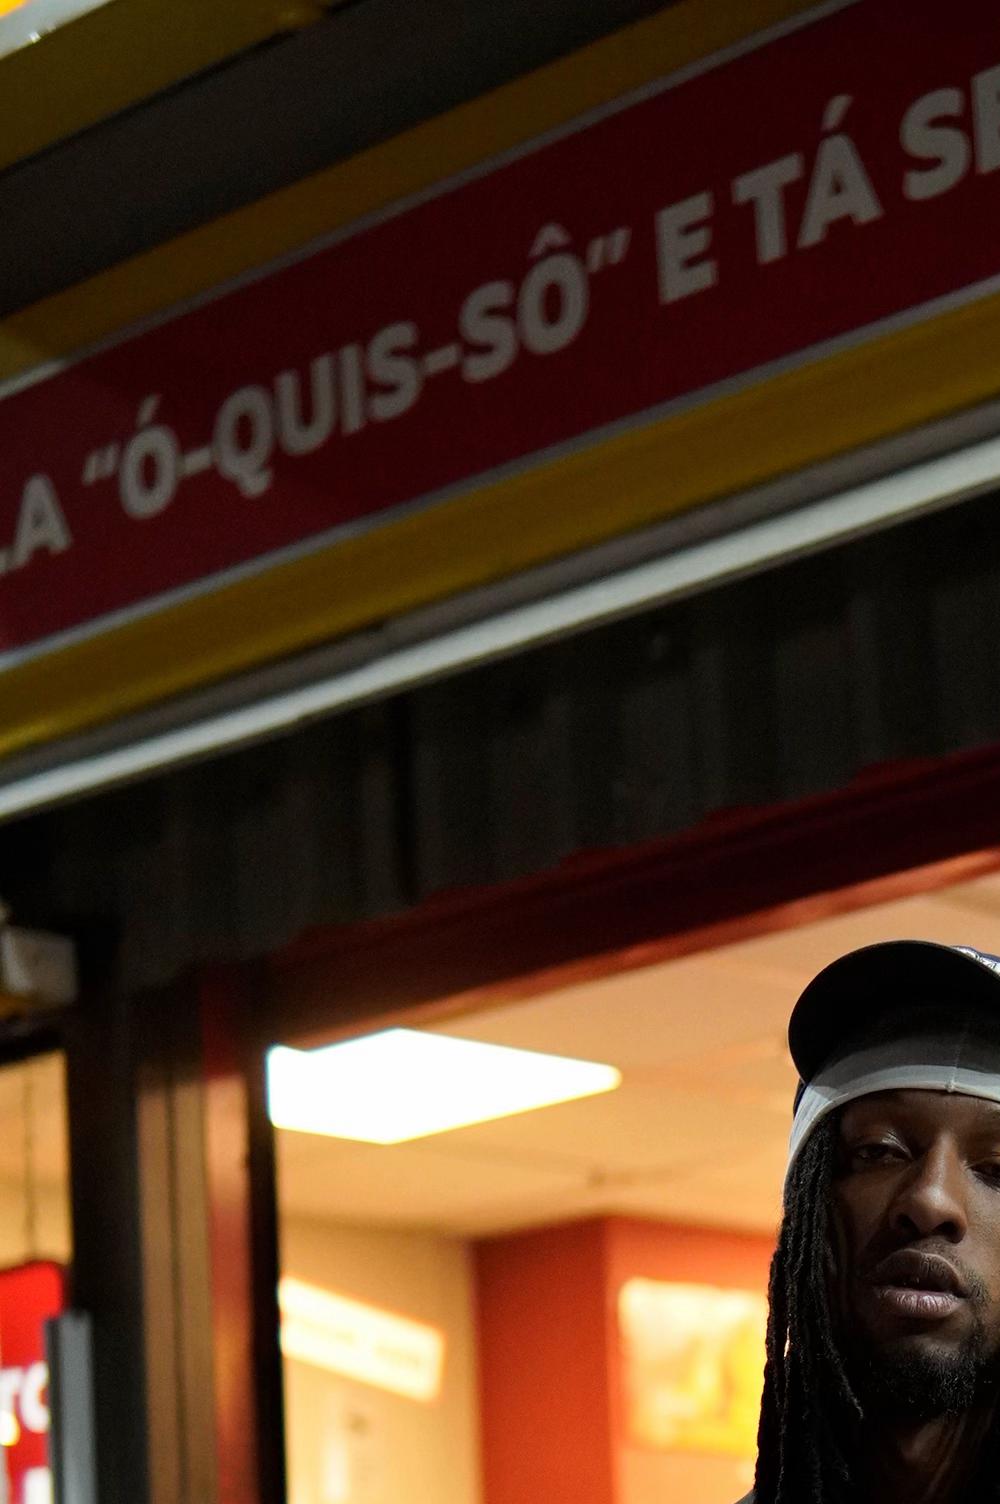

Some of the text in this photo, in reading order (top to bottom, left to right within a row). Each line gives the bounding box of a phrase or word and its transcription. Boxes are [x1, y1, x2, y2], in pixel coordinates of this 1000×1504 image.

[0, 472, 72, 575] A
[657, 192, 716, 304] E
[733, 96, 884, 264] TÁ
